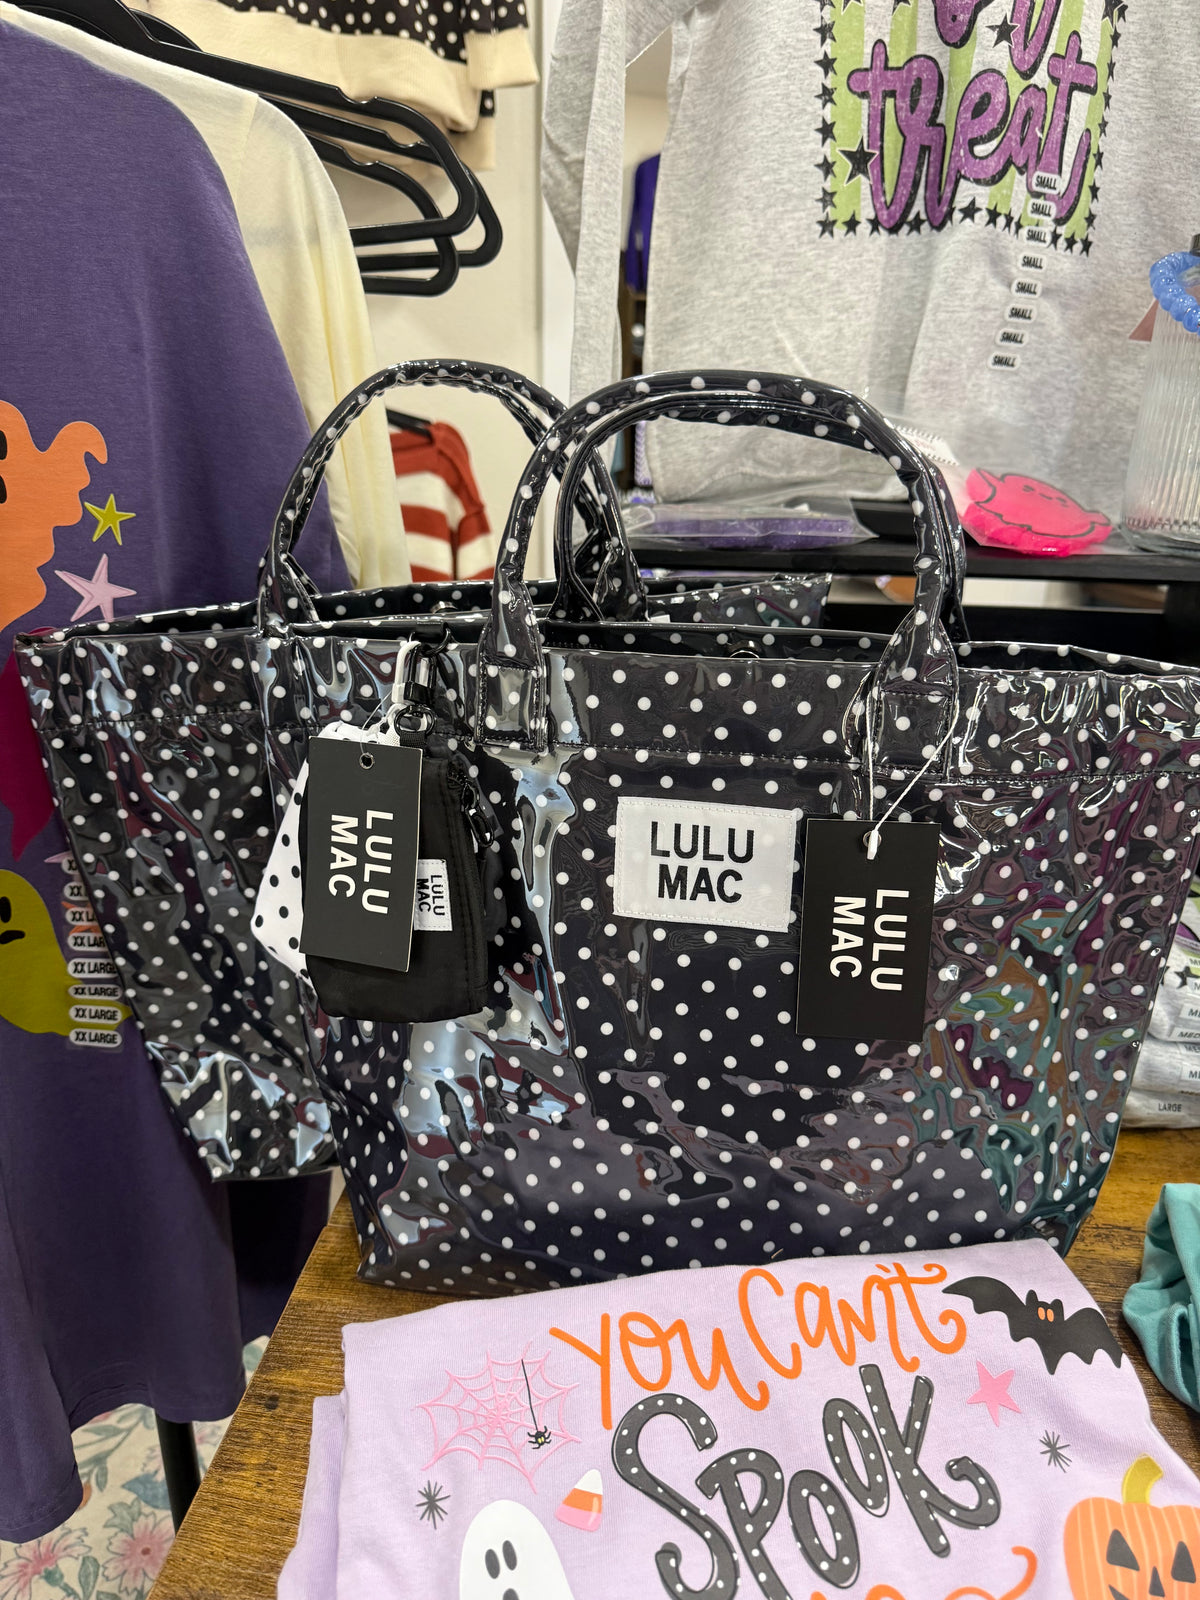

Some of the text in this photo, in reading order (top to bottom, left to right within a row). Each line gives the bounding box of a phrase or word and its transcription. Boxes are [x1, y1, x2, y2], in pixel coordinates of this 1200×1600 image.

[1035, 175, 1057, 190] SMALL
[1030, 202, 1052, 217] SMALL
[1026, 229, 1047, 244] SMALL
[1021, 255, 1043, 269] SMALL
[1015, 281, 1038, 295] SMALL
[1008, 307, 1033, 320] SMALL
[1000, 331, 1024, 344] SMALL
[991, 355, 1016, 368] SMALL
[651, 821, 754, 863] LULU
[328, 814, 359, 898] MAC
[362, 809, 394, 914] LULU
[658, 864, 743, 903] MAC
[416, 878, 431, 912] MAC
[430, 874, 445, 916] LULU
[71, 911, 84, 922] XX
[73, 936, 106, 947] XX LAR
[829, 896, 866, 978] MAC
[870, 889, 909, 991] LULU
[73, 961, 86, 973] XX
[74, 986, 119, 997] XX LARGE
[75, 1007, 119, 1020] XX LARGE
[75, 1031, 119, 1044] XX LARGE
[1158, 1103, 1182, 1113] LARGE
